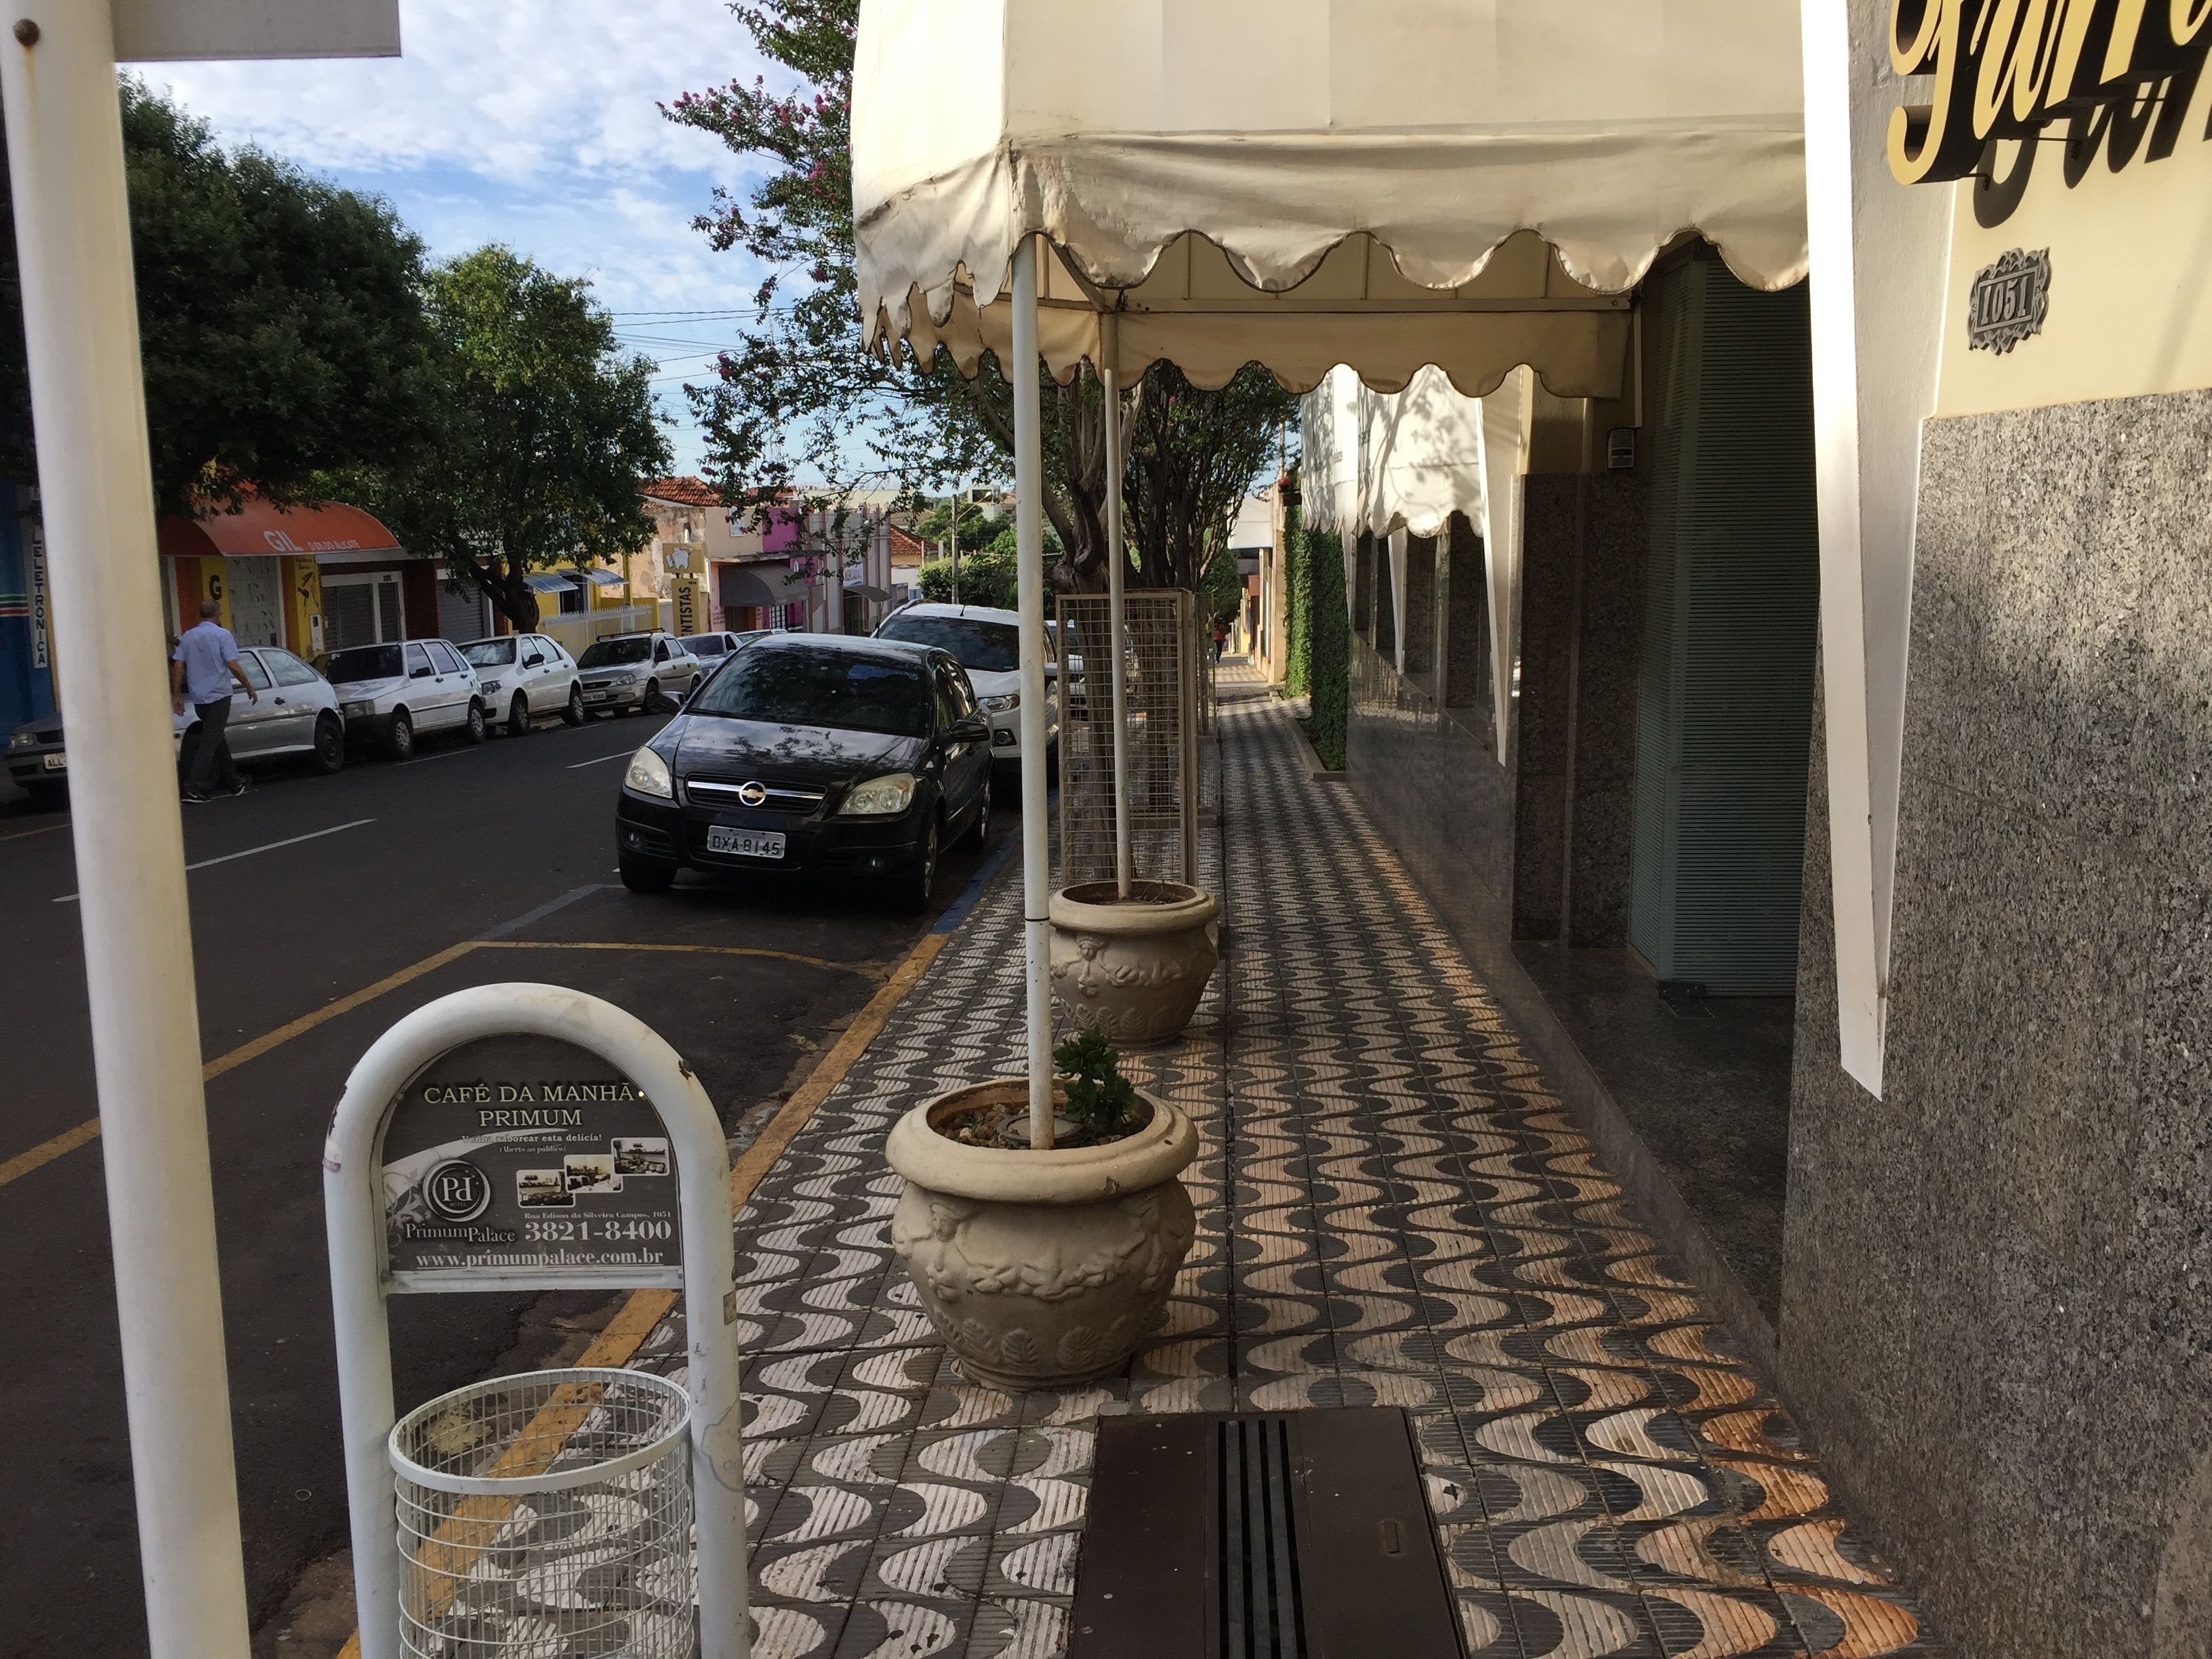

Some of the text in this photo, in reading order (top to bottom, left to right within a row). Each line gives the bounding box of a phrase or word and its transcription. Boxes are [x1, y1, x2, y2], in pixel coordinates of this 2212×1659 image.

[1980, 276, 2028, 325] 1051
[263, 531, 304, 552] GIL
[209, 575, 222, 600] G
[424, 1082, 635, 1104] CAFÉ DA MANHÃ
[479, 1109, 582, 1126] PRIMUM
[462, 1135, 493, 1143] Venha
[616, 1211, 650, 1220] Campos,
[525, 1220, 672, 1241] 3821-8400
[416, 1248, 664, 1269] www.primumpalace.com.br
